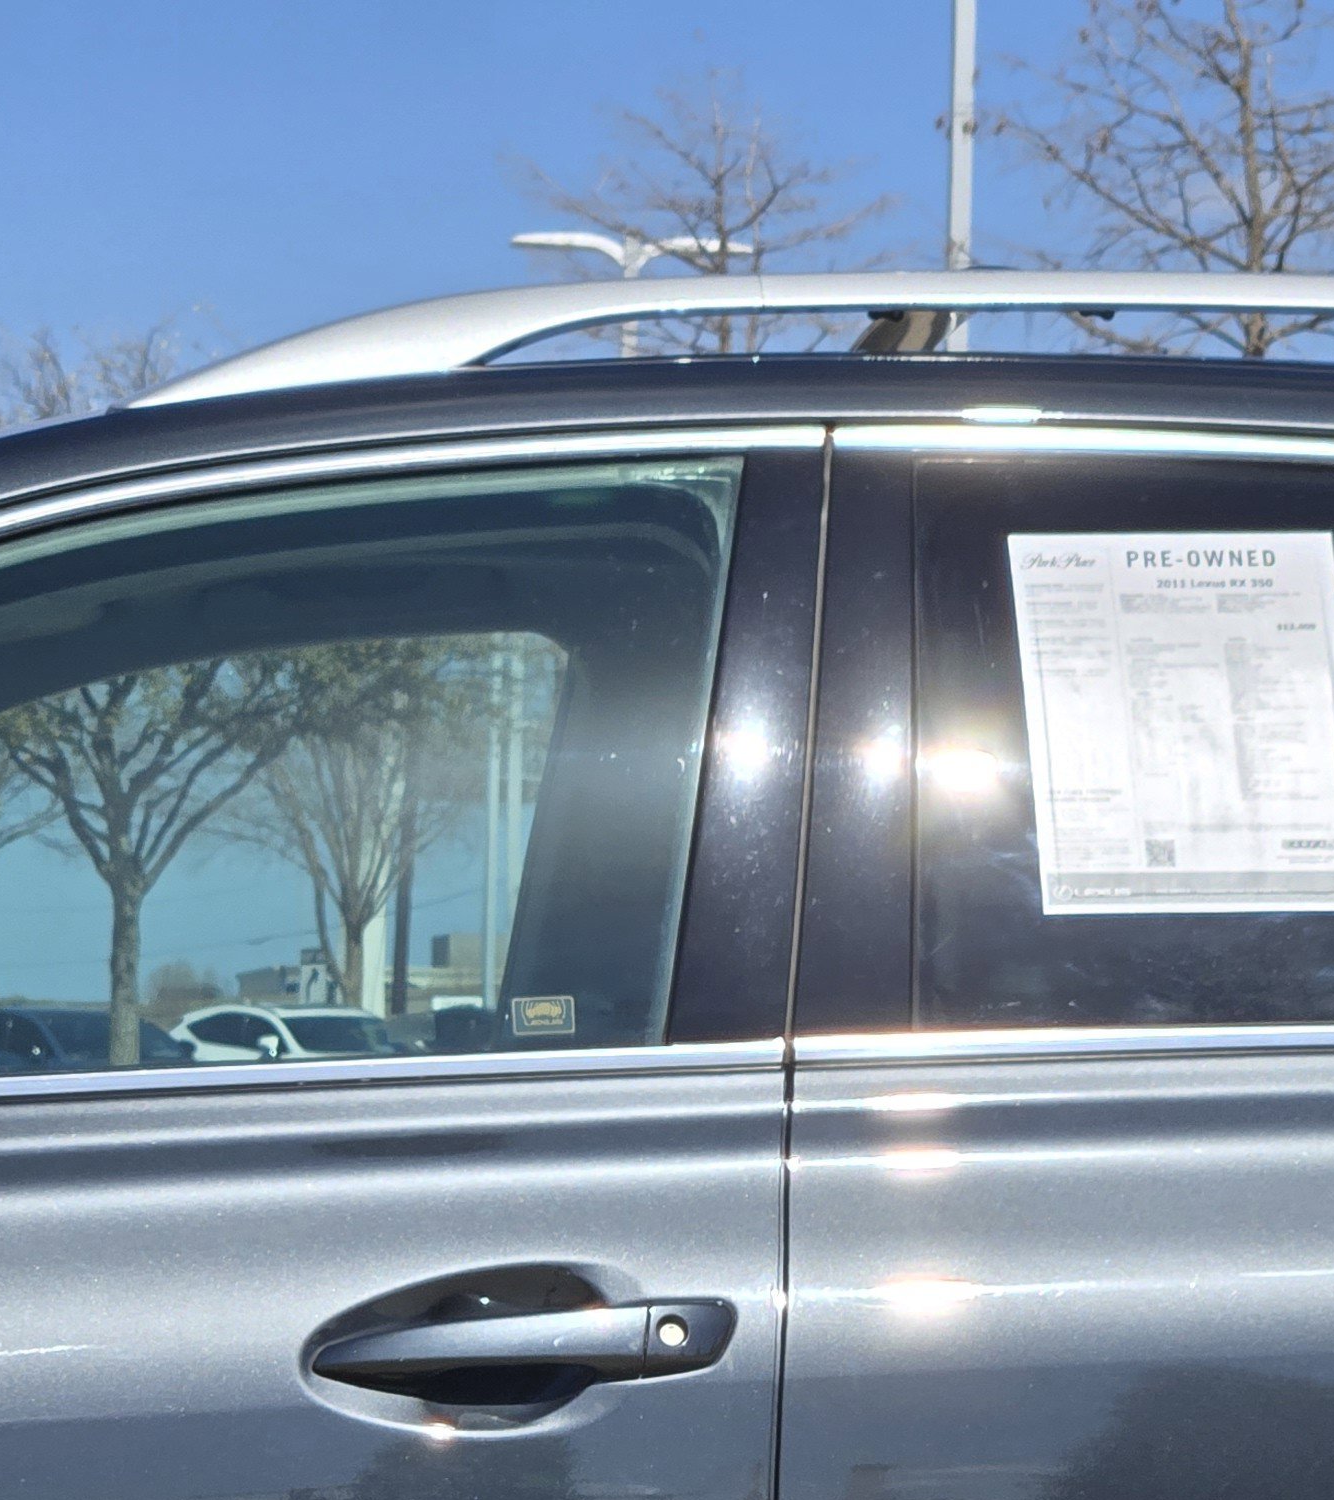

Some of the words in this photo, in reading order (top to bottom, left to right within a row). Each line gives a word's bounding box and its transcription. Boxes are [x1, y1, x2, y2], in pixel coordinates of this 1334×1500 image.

[1126, 550, 1276, 568] PRE-OWNED
[1190, 579, 1227, 589] Lexus
[1229, 579, 1247, 588] RX
